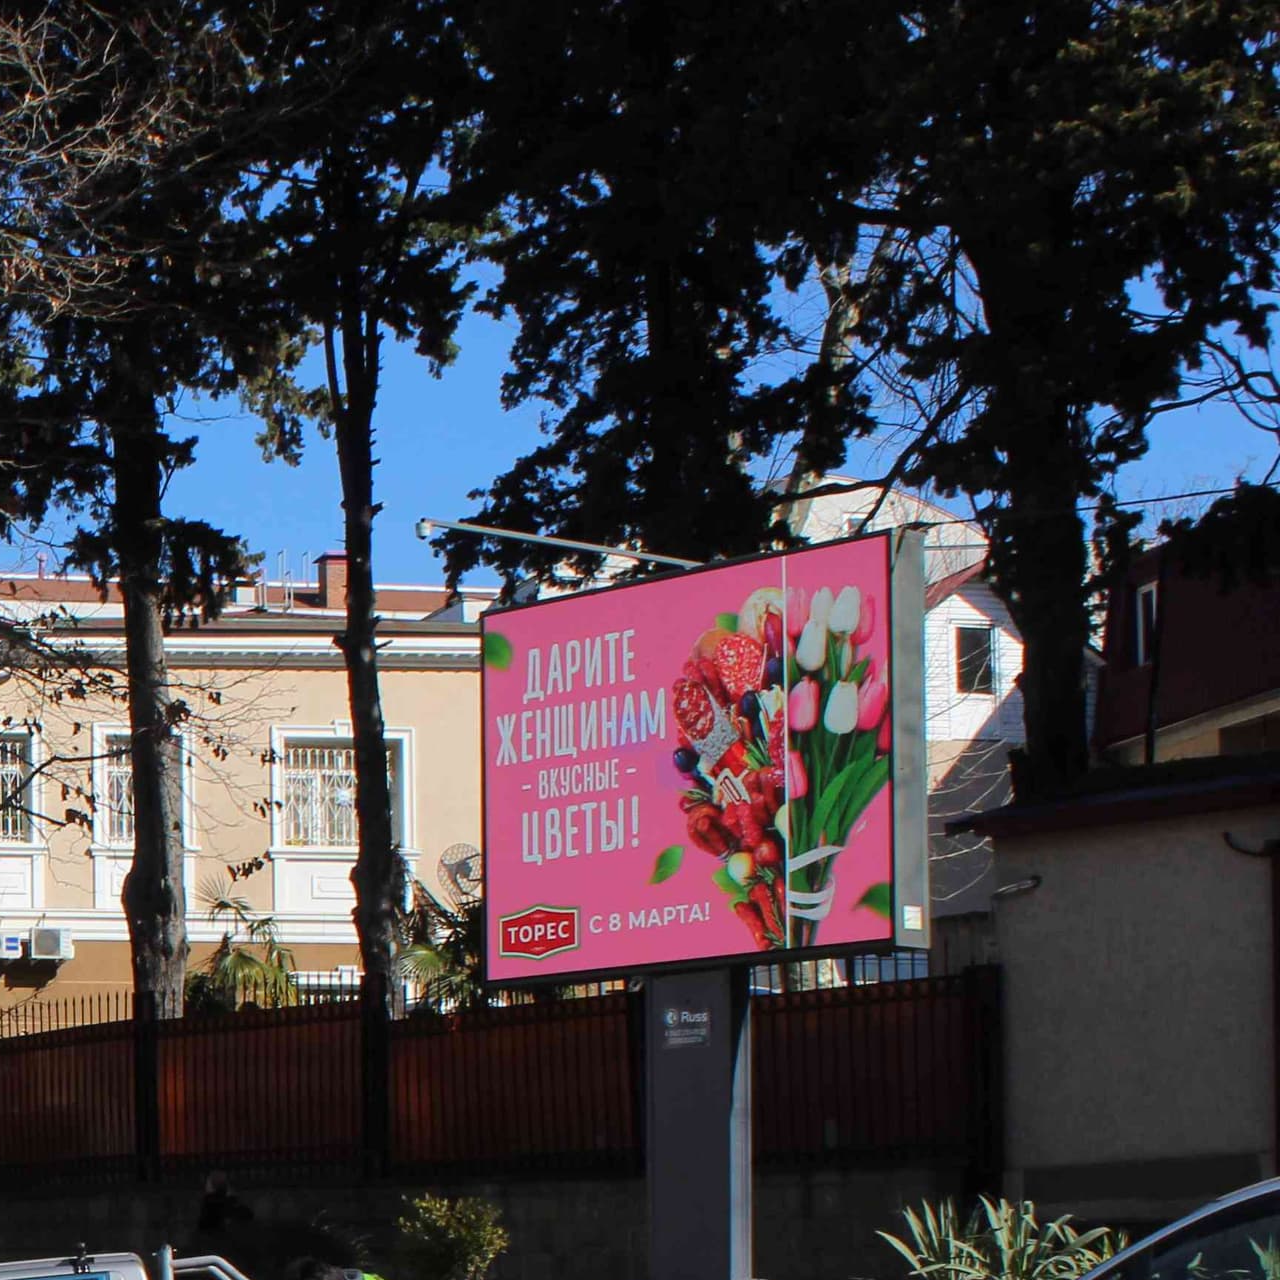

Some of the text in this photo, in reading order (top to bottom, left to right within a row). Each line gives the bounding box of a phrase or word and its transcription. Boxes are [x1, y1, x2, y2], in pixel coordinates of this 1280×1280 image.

[523, 629, 636, 704] ДАРИТЕ
[496, 688, 666, 767] ЖЕНЩИНАМ
[539, 759, 620, 800] ВКУСНЫЕ
[522, 795, 640, 865] ЦВЕТЫ!
[507, 920, 570, 944] ТОРЕС
[589, 902, 711, 934] С 8 МАРТА!
[680, 1011, 708, 1023] Russ
